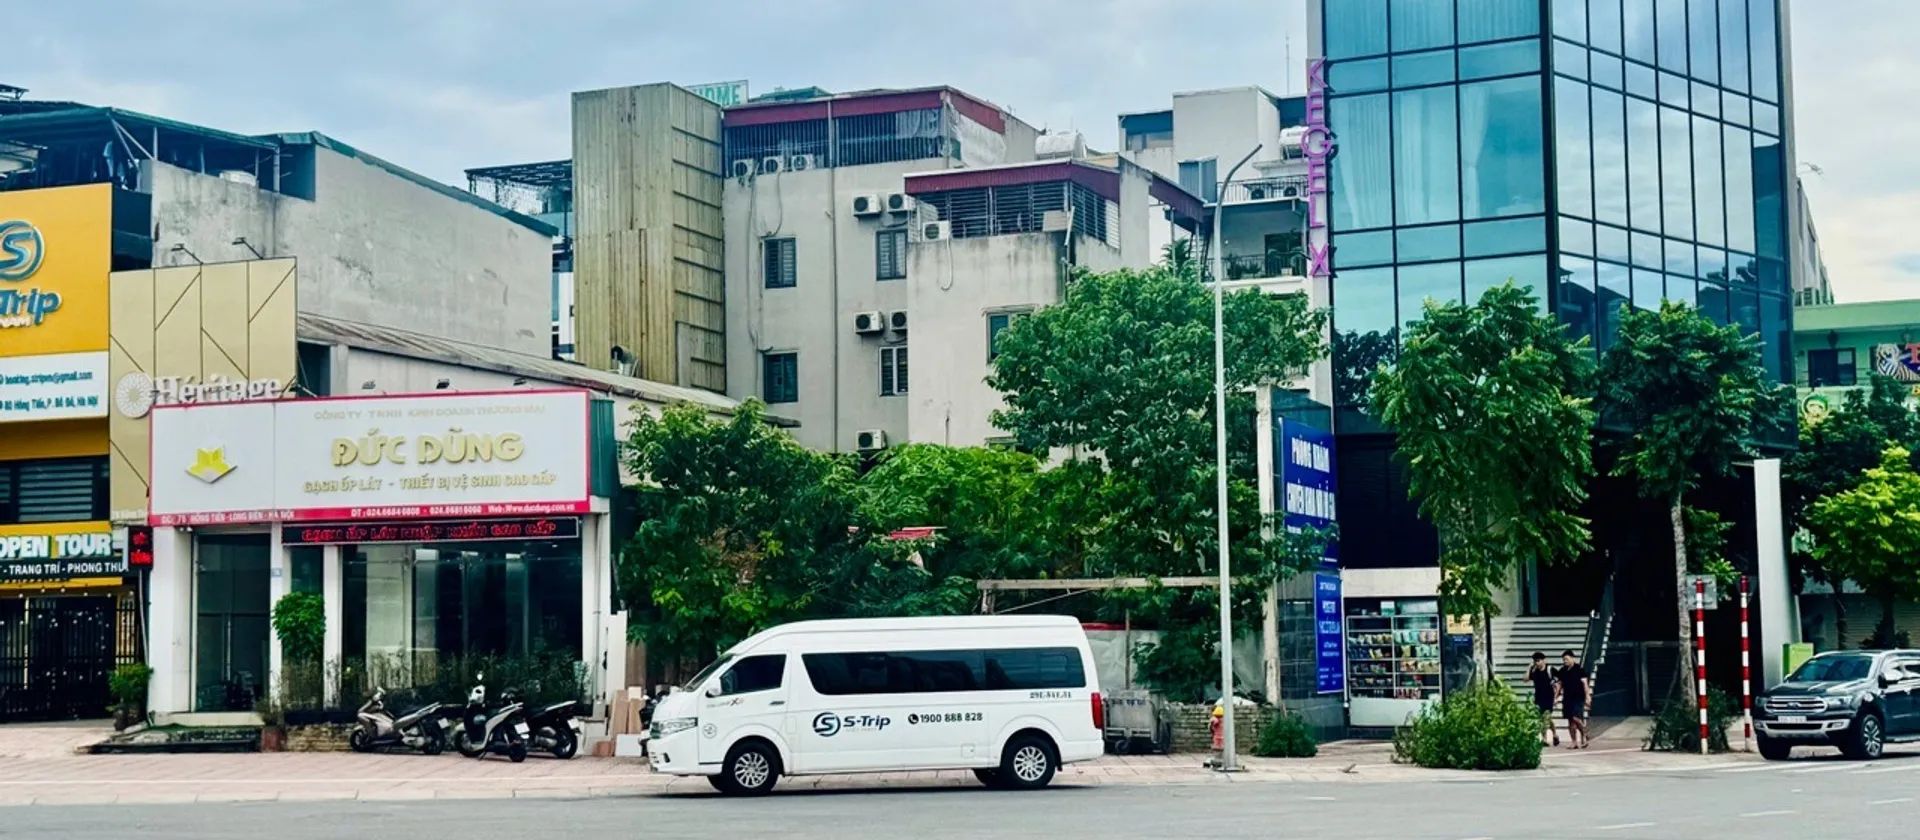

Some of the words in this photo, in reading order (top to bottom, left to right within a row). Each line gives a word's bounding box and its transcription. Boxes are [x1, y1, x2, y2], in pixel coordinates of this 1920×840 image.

[1301, 56, 1333, 228] KEGEL
[1309, 243, 1331, 277] X
[331, 427, 407, 467] ĐỨC
[417, 425, 526, 465] DŨNG
[304, 480, 339, 496] GẠCH
[340, 475, 358, 492] ỐP
[359, 475, 384, 491] LÁT
[399, 472, 435, 490] THIẾT
[452, 473, 469, 491] VỆ
[471, 473, 502, 488] SINH
[504, 473, 529, 487] CAO
[532, 468, 558, 487] CẤP
[55, 532, 111, 557] TOUR
[9, 564, 42, 575] TRANG
[44, 561, 60, 574] TRÍ
[67, 562, 102, 574] PHONG
[843, 715, 891, 730] S-Trip
[920, 713, 942, 723] 1900
[944, 713, 962, 722] 888
[964, 712, 983, 722] 828
